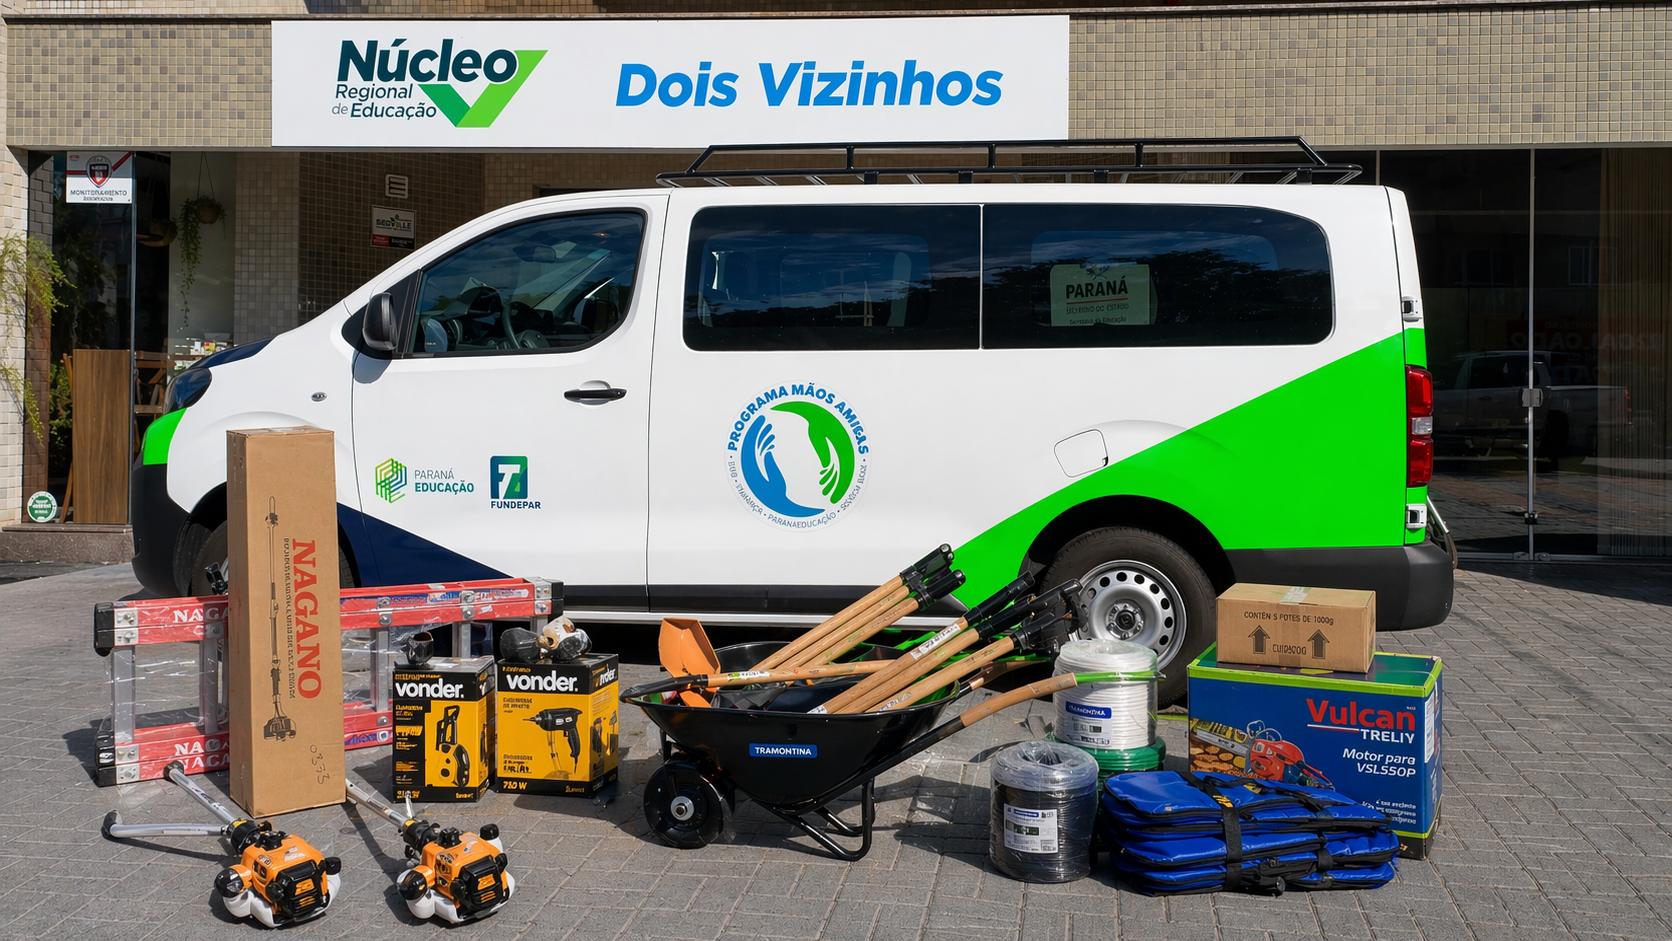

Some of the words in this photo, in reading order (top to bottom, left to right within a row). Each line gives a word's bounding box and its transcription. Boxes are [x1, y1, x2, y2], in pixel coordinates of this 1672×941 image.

[337, 38, 517, 82] Núcleo
[335, 83, 413, 101] Regional
[615, 61, 740, 107] Dois
[758, 59, 1004, 107] Vizinhos
[332, 103, 349, 115] de
[351, 102, 437, 120] Educação
[1066, 275, 1128, 299] PARANÁ
[728, 386, 788, 451] PROGRAMA
[792, 382, 835, 404] MÃOS
[415, 468, 455, 480] PARANÁ
[415, 480, 475, 495] EDUCAÇÃO
[490, 501, 541, 510] FUNDEPAR
[292, 538, 322, 699] NAGANO
[1280, 614, 1301, 622] POTES
[1306, 698, 1415, 731] Vulcan
[754, 747, 812, 755] TRAMONTINA
[1342, 748, 1384, 762] Motor
